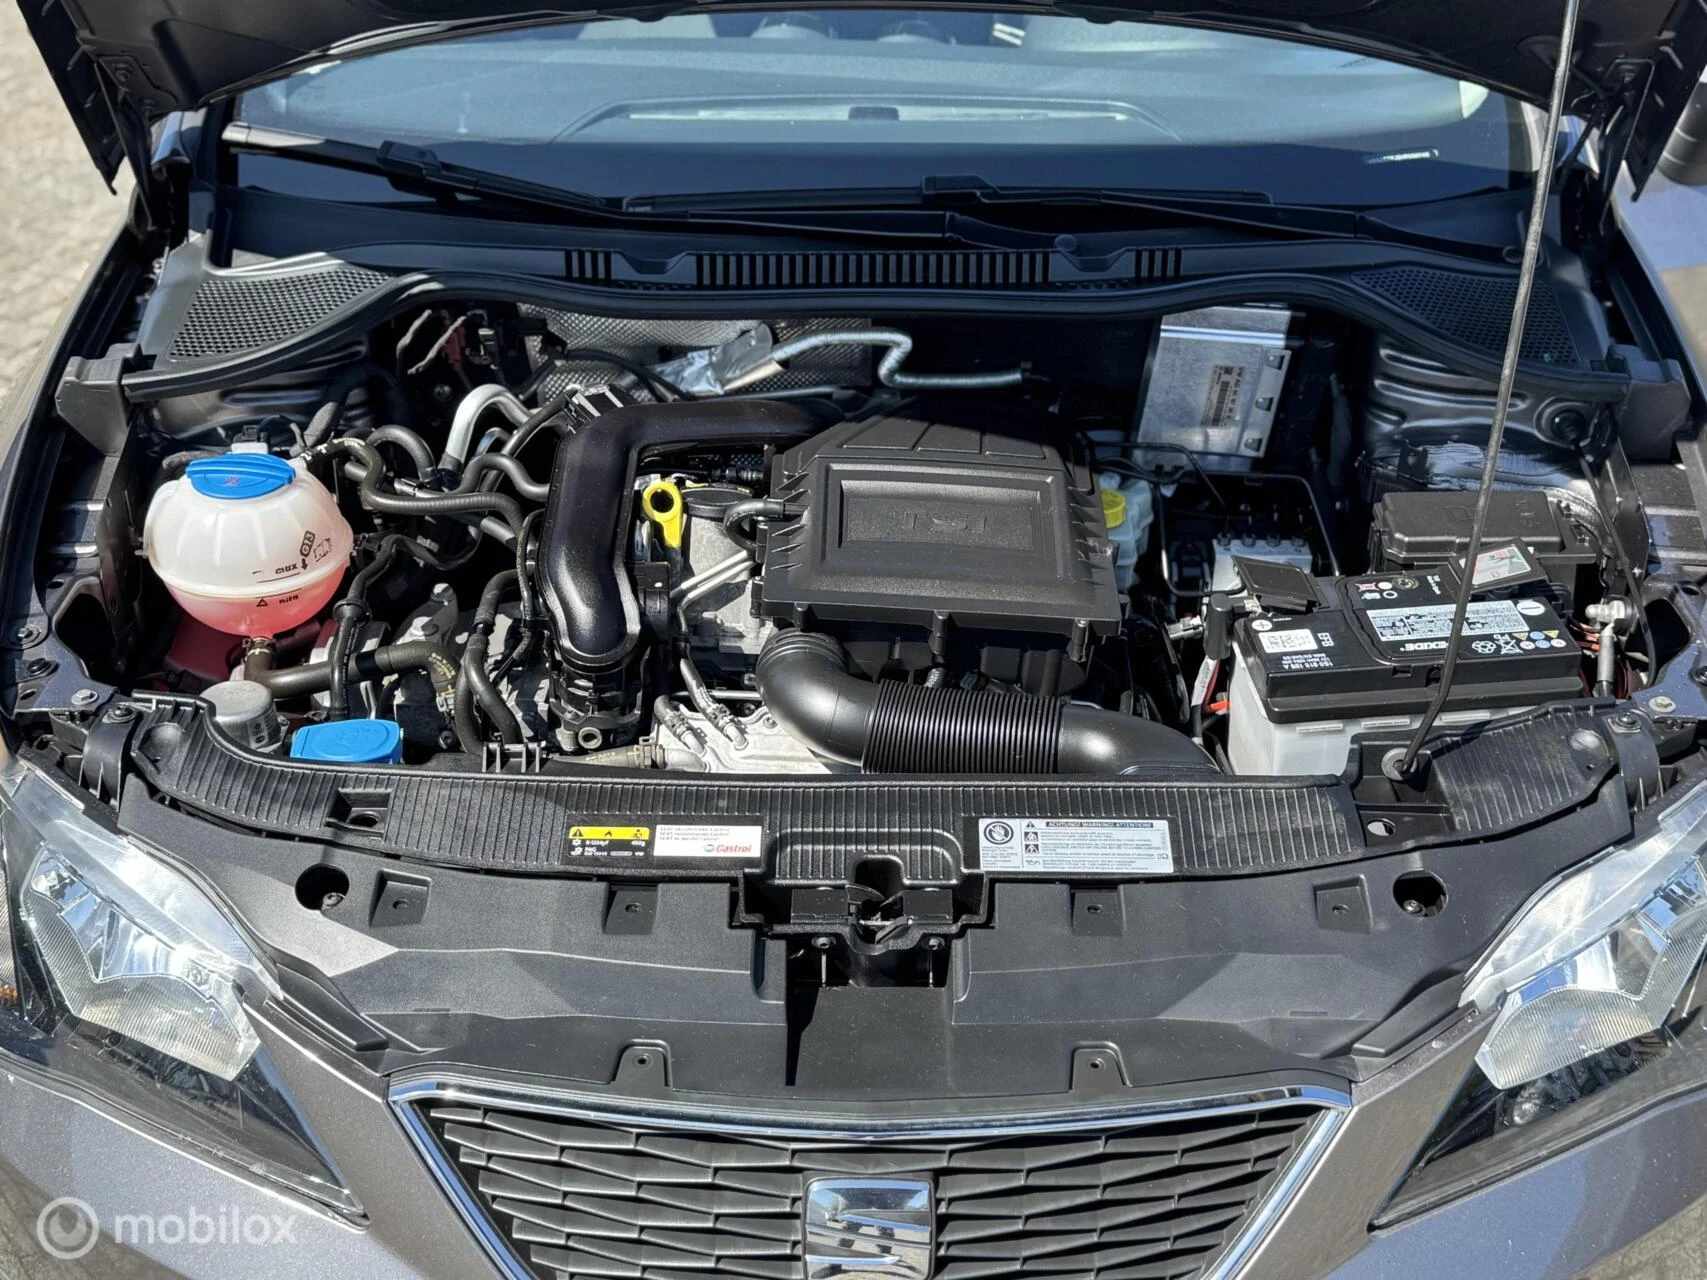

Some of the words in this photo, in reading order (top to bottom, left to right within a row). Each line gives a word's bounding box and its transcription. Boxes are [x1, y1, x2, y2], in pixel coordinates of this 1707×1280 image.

[301, 532, 314, 556] G13
[275, 563, 298, 575] max
[1317, 632, 1335, 647] EFB
[1404, 641, 1448, 651] EXIDE
[715, 843, 753, 853] Castrol
